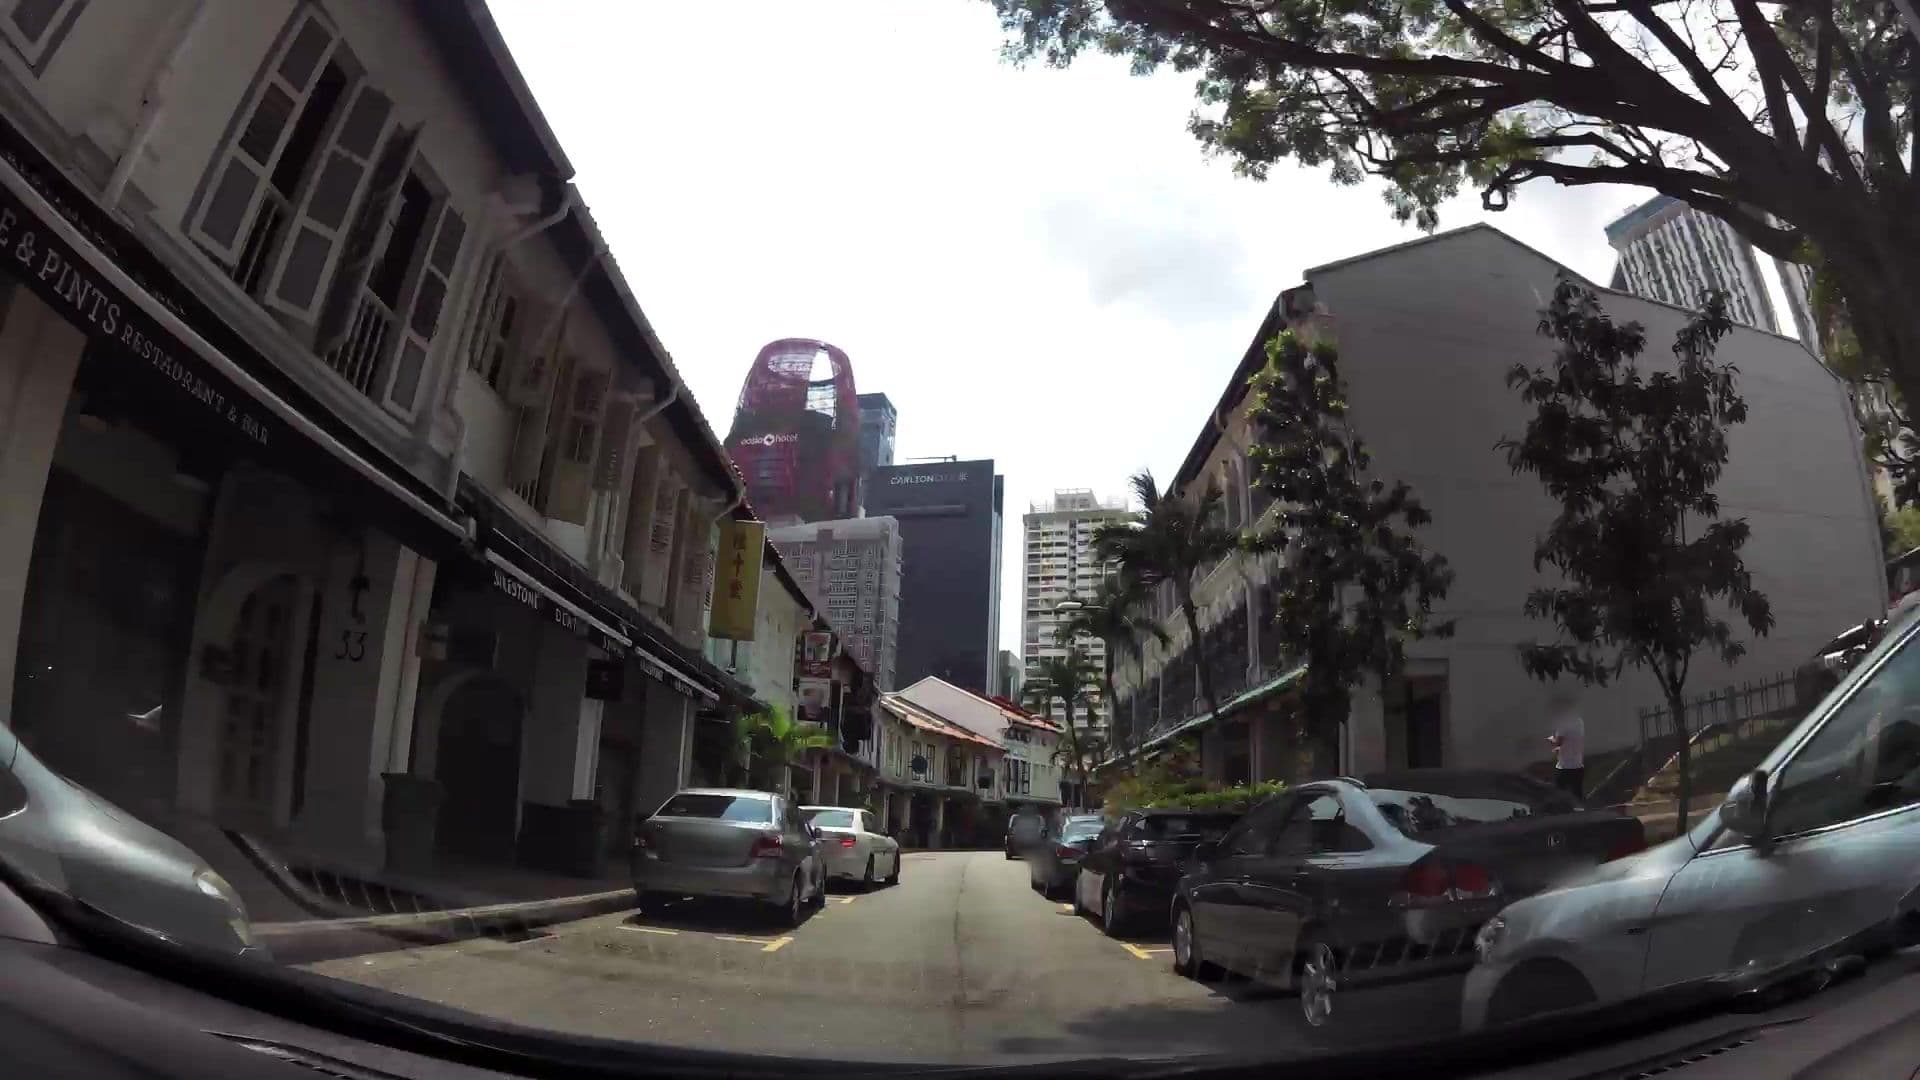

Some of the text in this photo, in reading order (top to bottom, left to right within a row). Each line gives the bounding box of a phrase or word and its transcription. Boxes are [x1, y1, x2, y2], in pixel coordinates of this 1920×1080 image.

[15, 231, 36, 267] &
[37, 246, 120, 334] PINTS
[119, 322, 226, 414] RESTAURANT
[334, 630, 369, 661] 33
